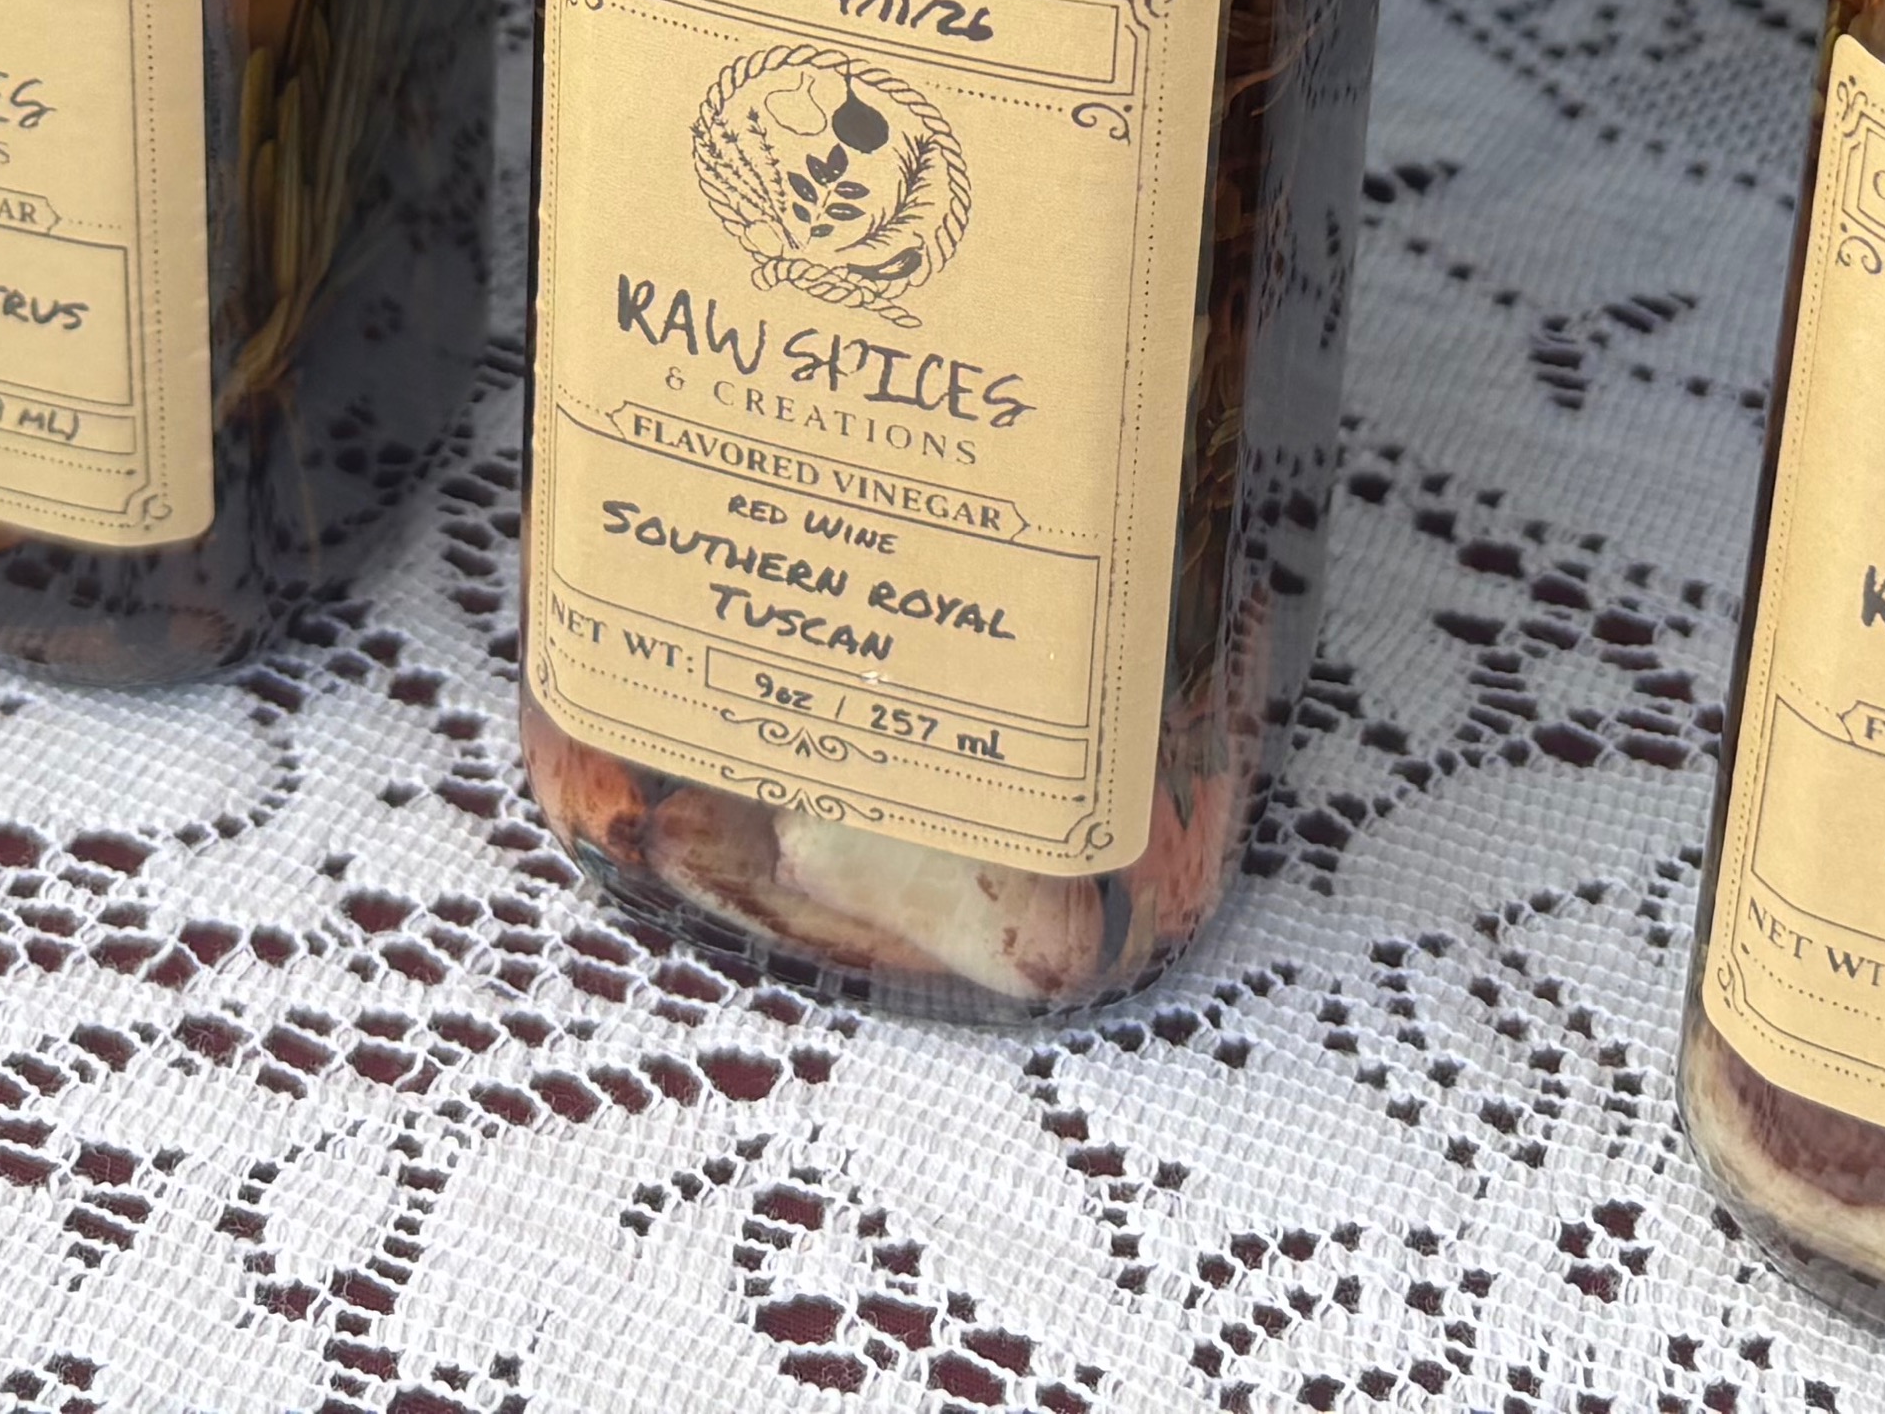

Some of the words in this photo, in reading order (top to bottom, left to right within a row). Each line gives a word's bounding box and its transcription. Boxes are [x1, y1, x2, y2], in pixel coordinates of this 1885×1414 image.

[617, 273, 766, 376] RAW
[783, 327, 1037, 429] SPICES
[666, 366, 684, 390] &
[713, 380, 977, 466] CREATIONS
[632, 415, 820, 487] FLAVORED
[831, 468, 1002, 532] VINEGAR
[728, 494, 788, 525] RED
[804, 511, 900, 556] WINE
[602, 499, 849, 599] SOUTHERN
[868, 579, 1016, 640] ROYAL
[710, 583, 895, 662] TUSCAN
[551, 592, 607, 645] NET
[624, 627, 695, 673] WT:
[870, 703, 938, 742] 257
[1748, 898, 1813, 961] NET
